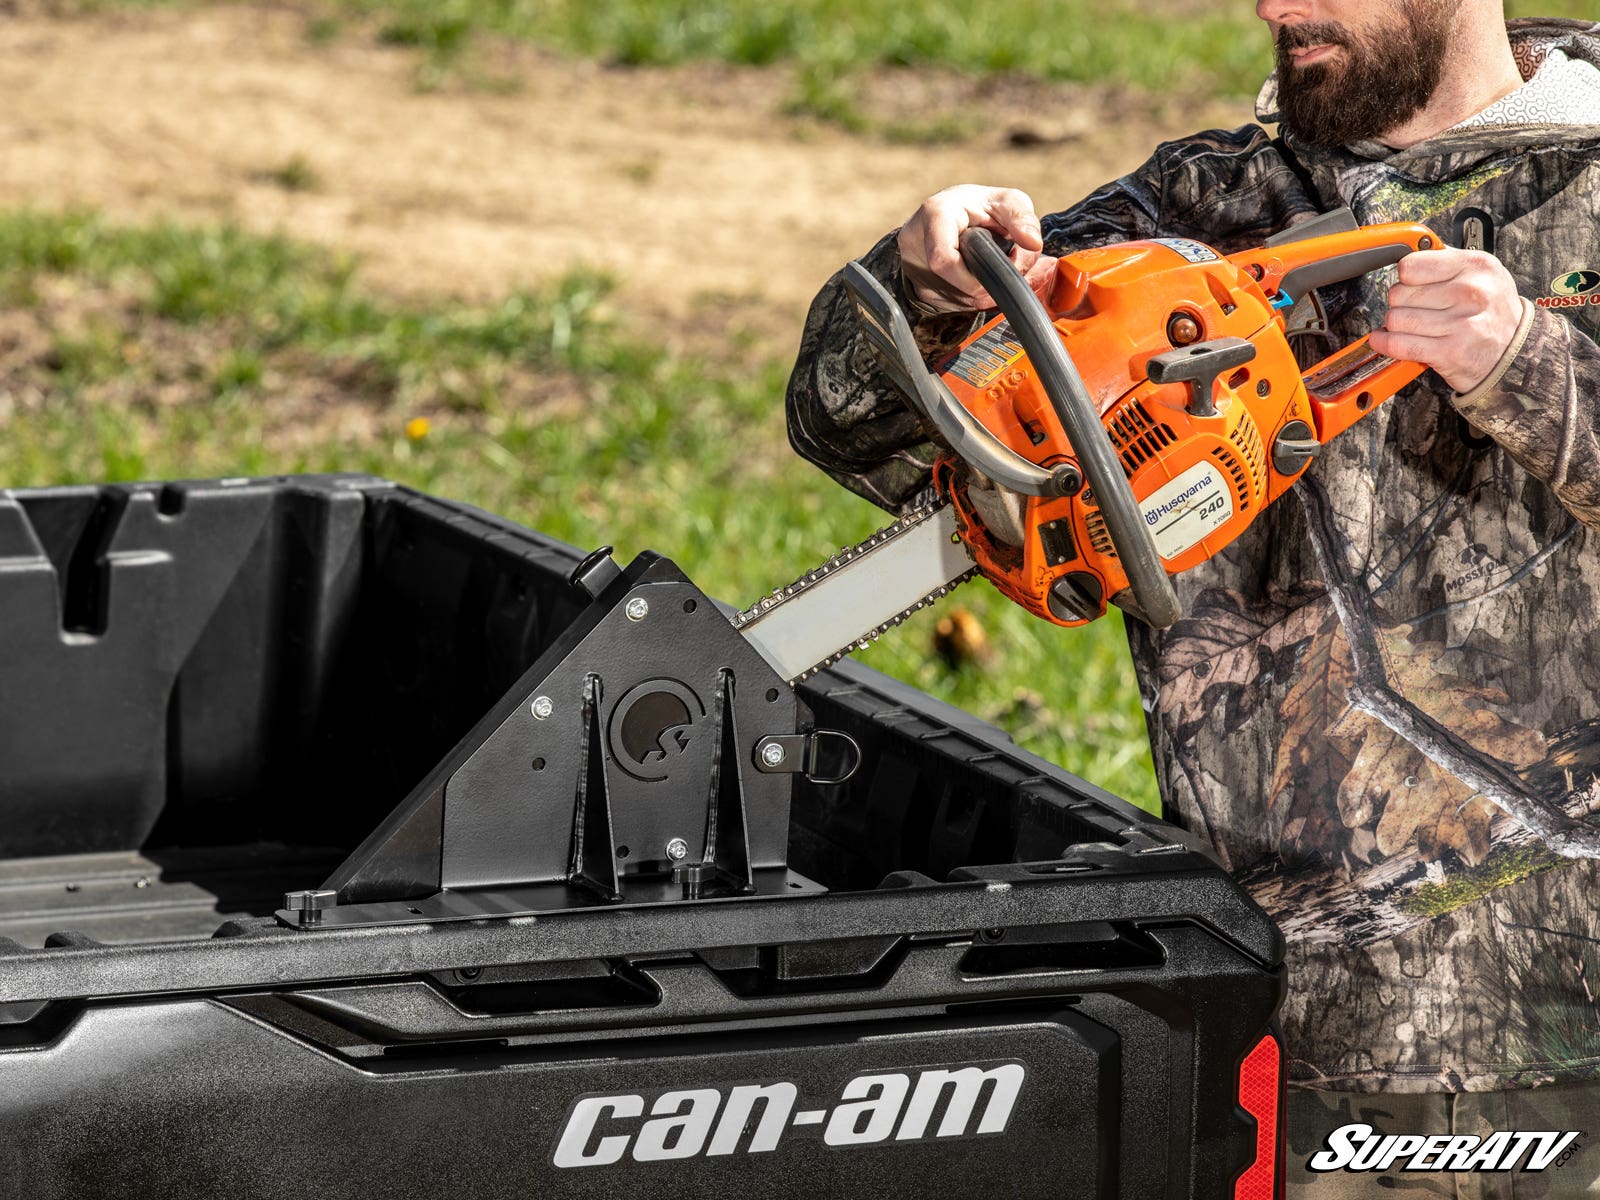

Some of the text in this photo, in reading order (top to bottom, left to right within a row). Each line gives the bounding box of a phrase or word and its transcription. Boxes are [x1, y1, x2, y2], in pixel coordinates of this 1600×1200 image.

[1536, 294, 1589, 308] MOSSY
[1157, 475, 1212, 518] Husqvarna
[1200, 496, 1224, 520] 240
[1446, 566, 1484, 592] MOSSY
[553, 1063, 1026, 1169] can-am
